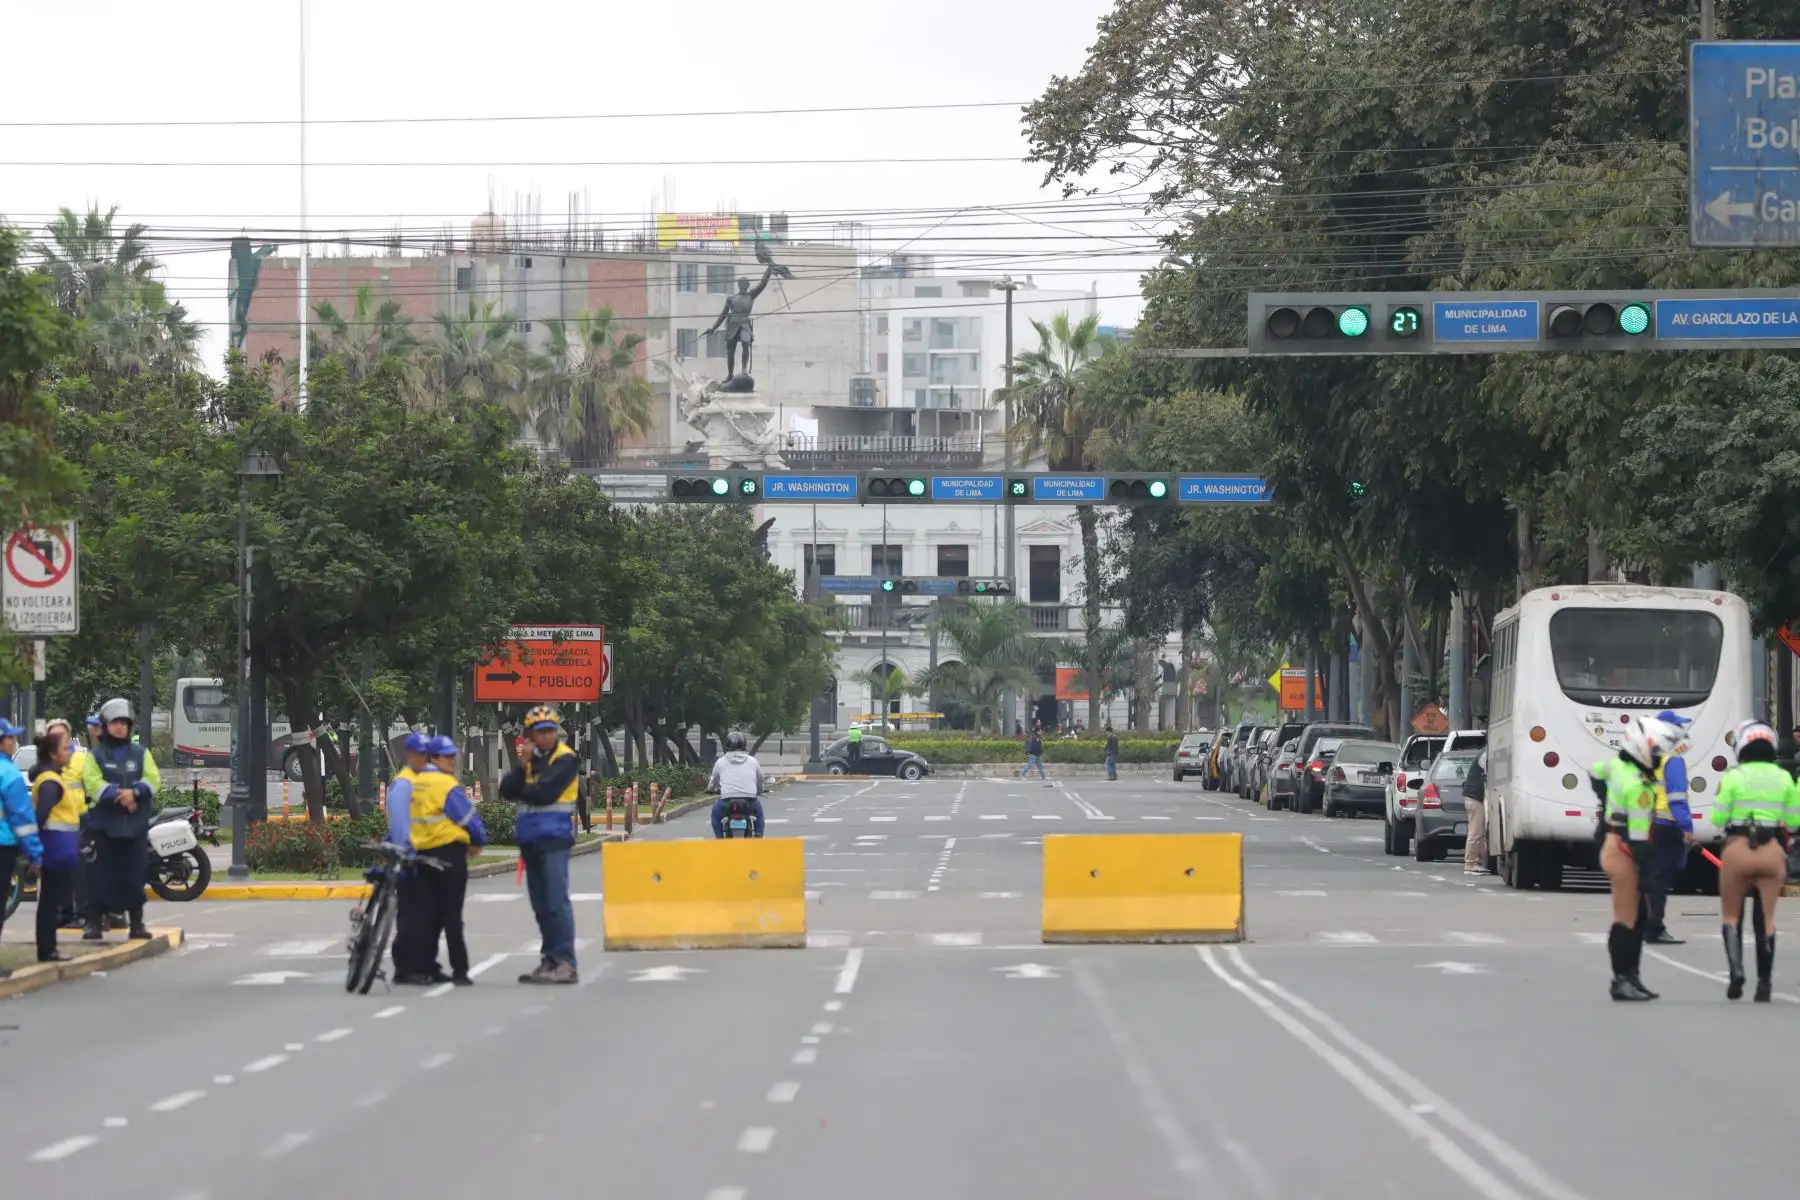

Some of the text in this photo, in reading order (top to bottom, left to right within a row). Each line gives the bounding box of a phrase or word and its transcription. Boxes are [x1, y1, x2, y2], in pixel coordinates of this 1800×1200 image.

[1745, 67, 1800, 99] Pla
[1747, 117, 1800, 149] Bol
[1445, 309, 1527, 319] MUNICIPALIDAD
[1672, 312, 1798, 325] AV. GARCILAZO DE LA
[1393, 313, 1417, 331] 27
[1464, 324, 1507, 334] DE LIMA
[743, 481, 756, 493] 28
[771, 483, 849, 493] JR. WASHINGTON
[941, 480, 994, 488] MUNICIPALIDAD
[1013, 483, 1025, 495] 28
[1043, 480, 1096, 488] MUNICIPALIDAD
[955, 489, 982, 497] DE LIMA
[1056, 489, 1084, 497] DE LIMA
[1187, 485, 1266, 495] JR. WASHINGTON
[6, 596, 73, 608] NO VOLTEAR A
[526, 675, 593, 688] T. PUBLICO
[1600, 695, 1672, 706] VEGUZTI
